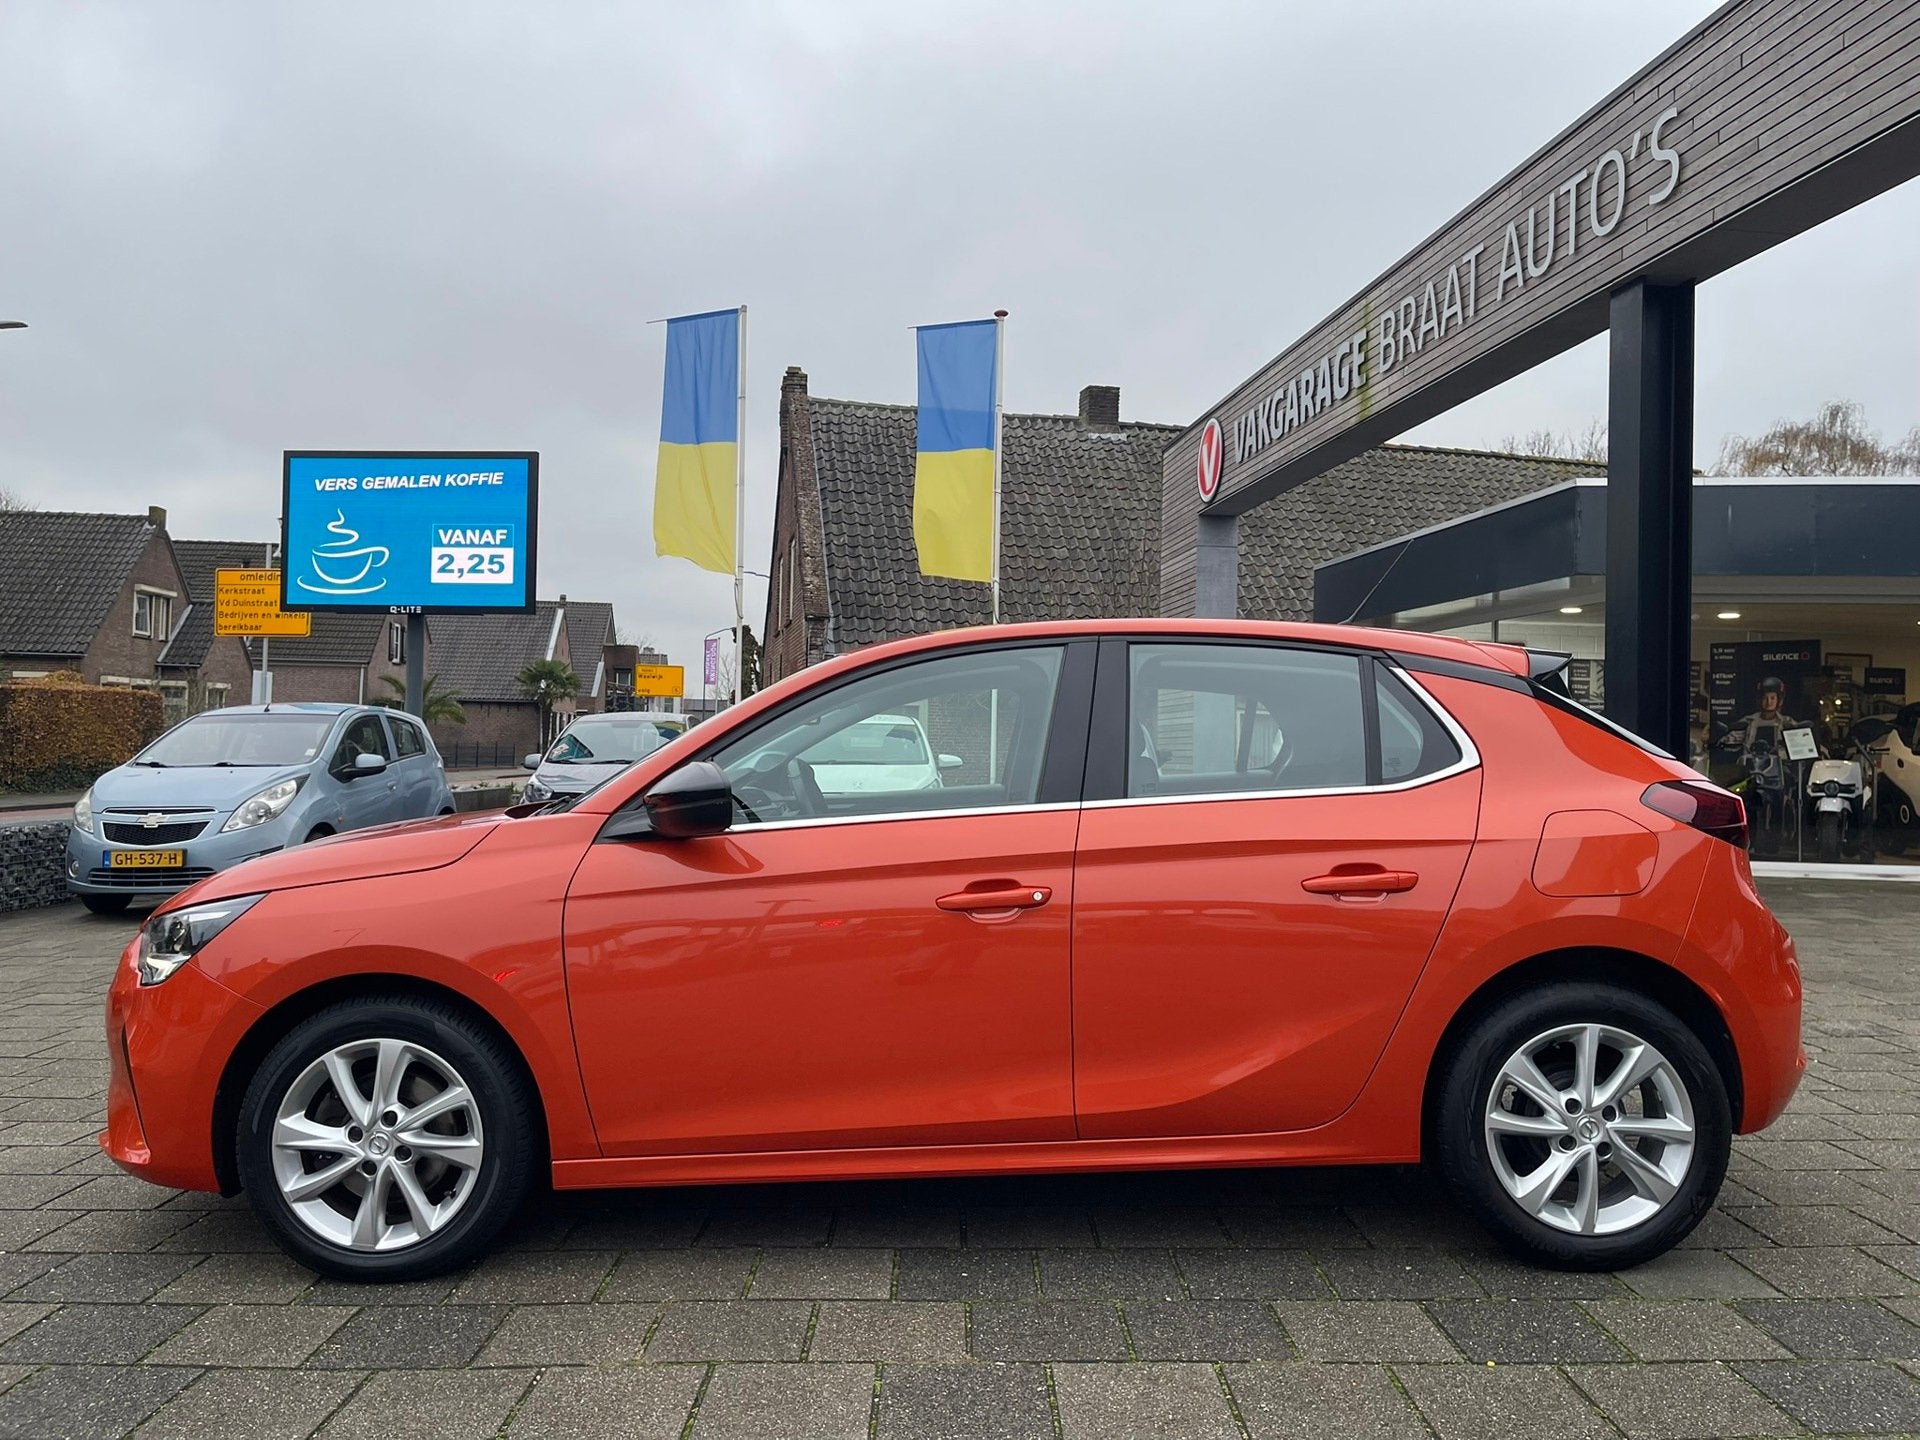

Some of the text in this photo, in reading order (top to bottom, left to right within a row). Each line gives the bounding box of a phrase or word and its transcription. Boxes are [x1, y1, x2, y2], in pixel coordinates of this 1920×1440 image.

[1234, 107, 1681, 464] VAKGARAGE BRAAT AUTO'S
[315, 472, 504, 491] VERS GEMALEN KOFFIE
[438, 529, 508, 545] VANAF
[436, 553, 506, 578] 2,25
[240, 572, 281, 581] omleidin
[218, 587, 265, 595] Kerkstraat
[218, 611, 259, 620] Bedrijven
[1762, 653, 1800, 661] SILENCE
[115, 853, 177, 865] GH-537-H
